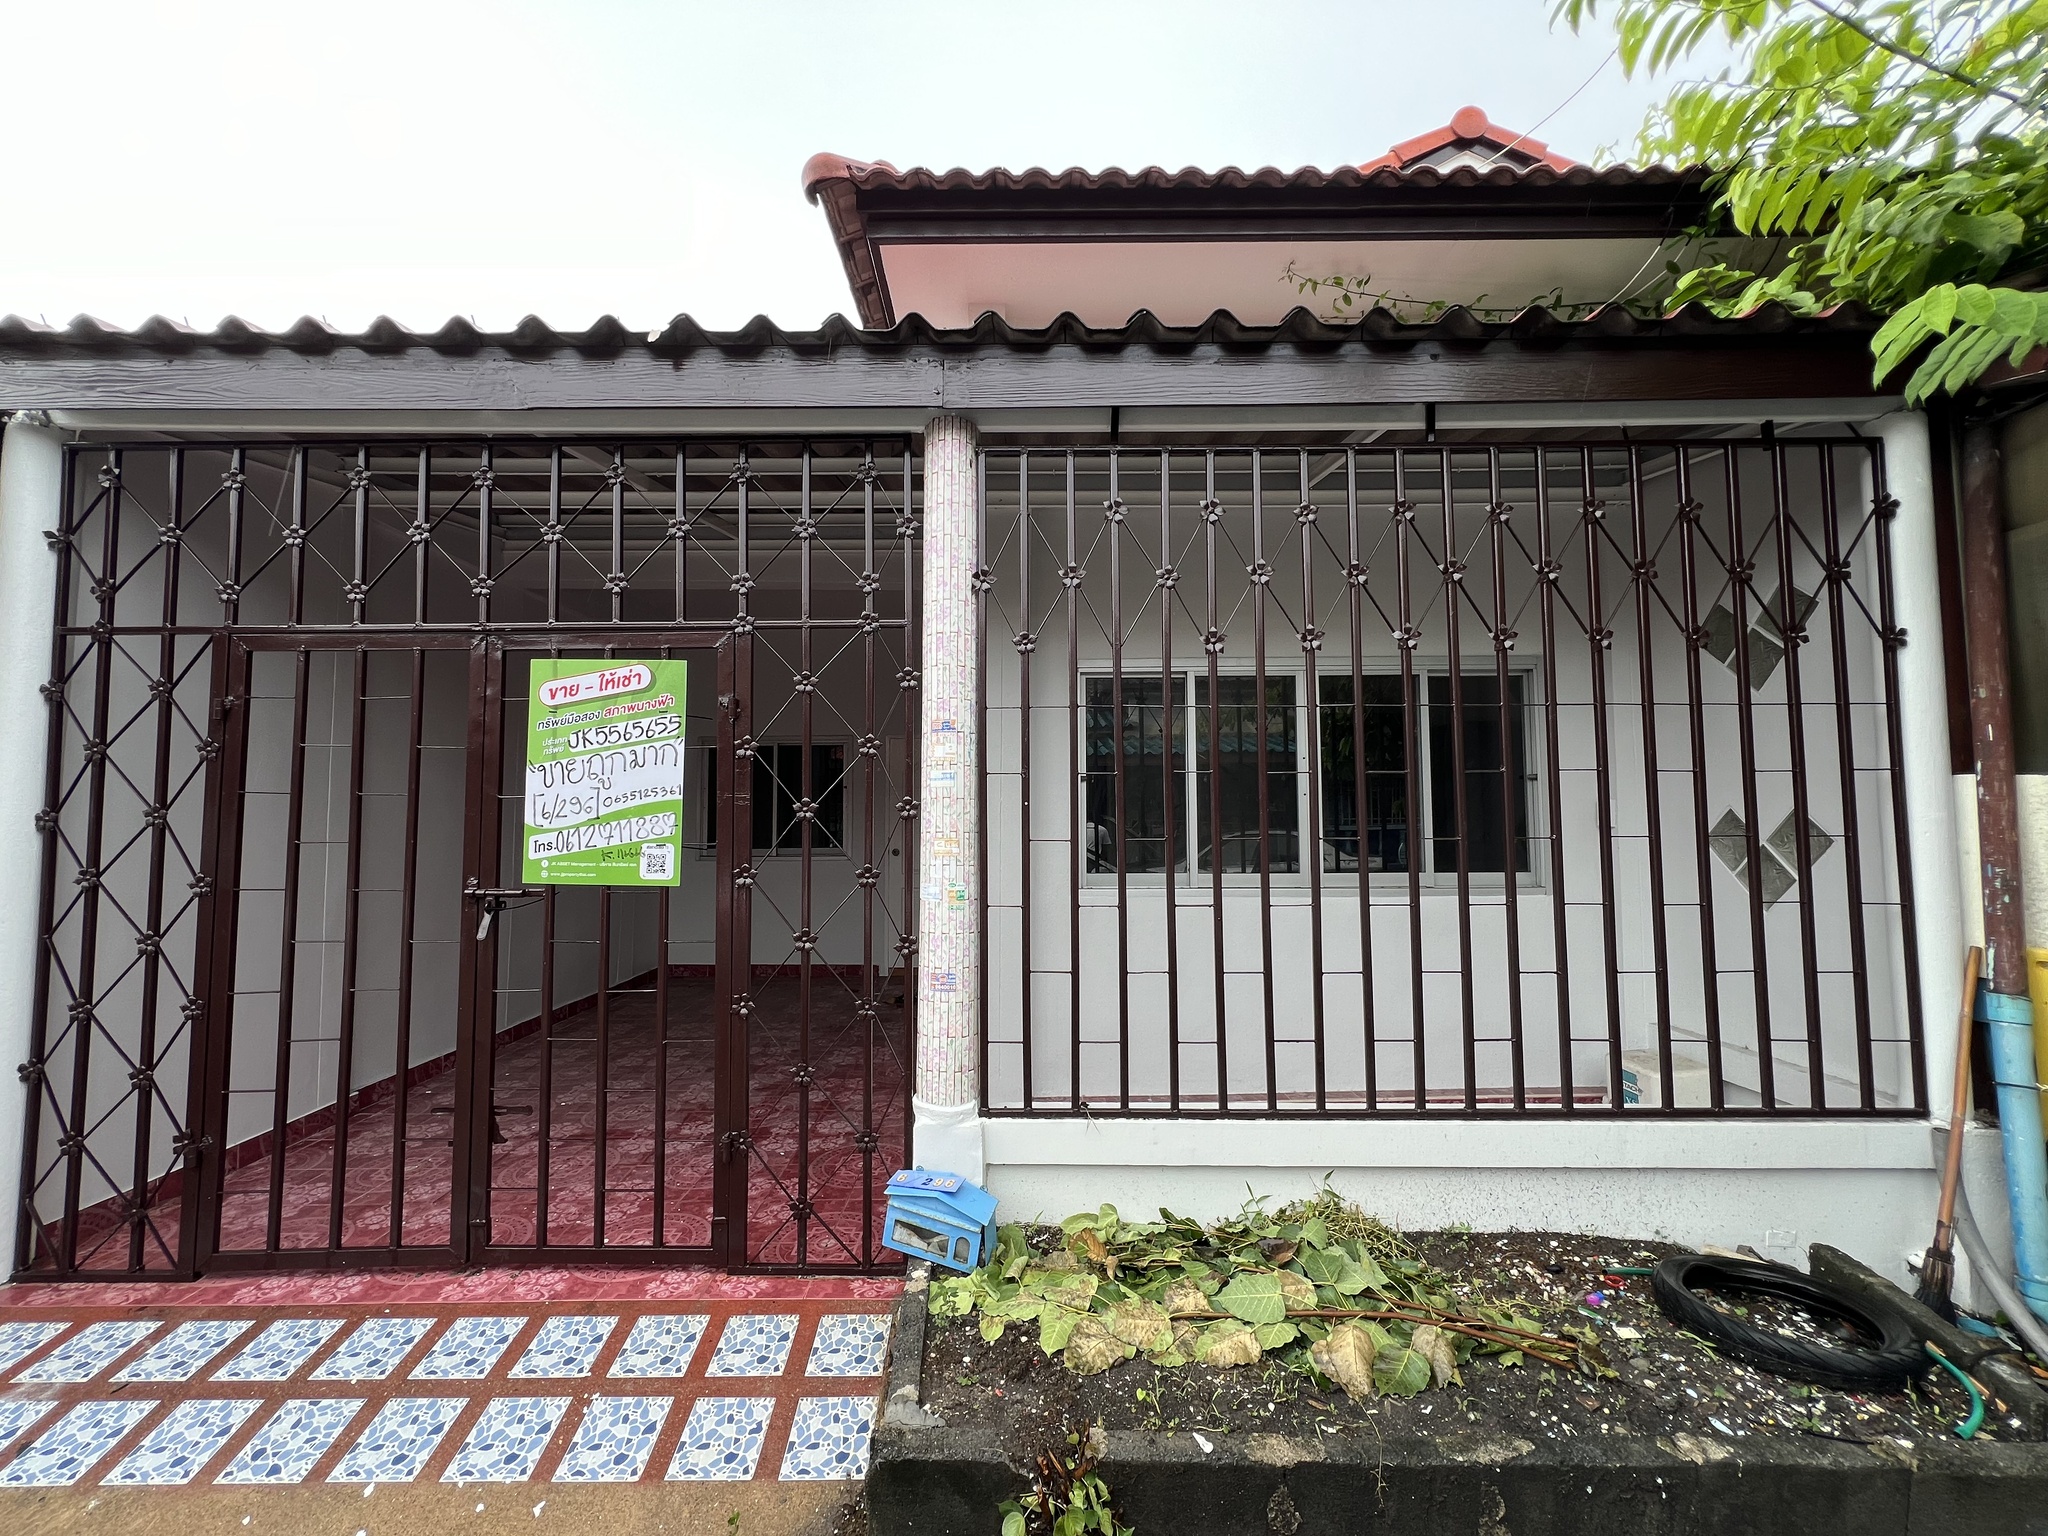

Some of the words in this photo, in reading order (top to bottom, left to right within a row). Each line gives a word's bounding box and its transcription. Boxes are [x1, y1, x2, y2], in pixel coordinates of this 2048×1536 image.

[548, 684, 579, 701] ขาย
[598, 669, 642, 693] ให้เช่า
[537, 711, 601, 731] ทรัพย์มือสอง
[603, 694, 675, 719] สภาพนางฟ้า
[568, 715, 683, 750] JK5565655
[603, 784, 682, 808] 0655125361
[533, 839, 557, 854] โทร.
[556, 812, 679, 853] 0612711887
